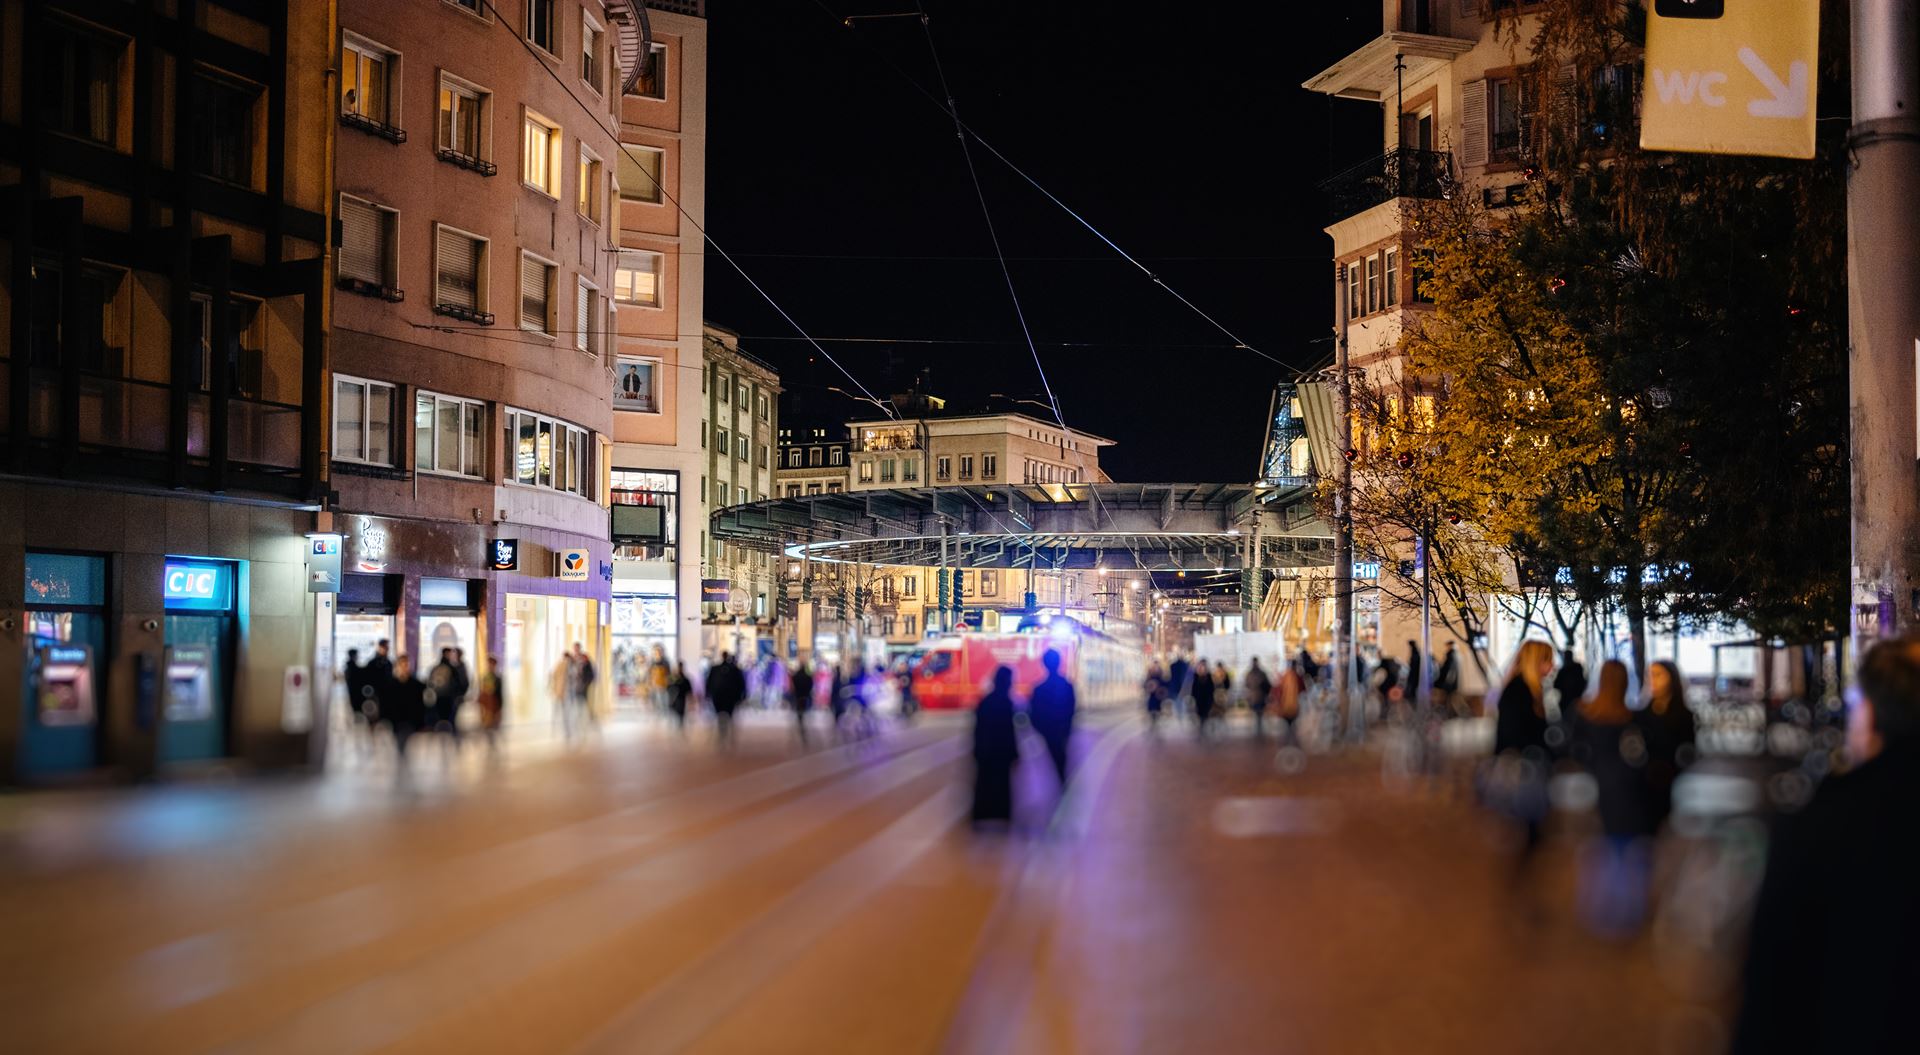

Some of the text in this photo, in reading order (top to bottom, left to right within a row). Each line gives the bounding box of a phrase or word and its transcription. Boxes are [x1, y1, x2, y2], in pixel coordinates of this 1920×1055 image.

[1653, 68, 1728, 107] WC
[315, 542, 336, 553] CIC
[169, 571, 213, 594] CIC
